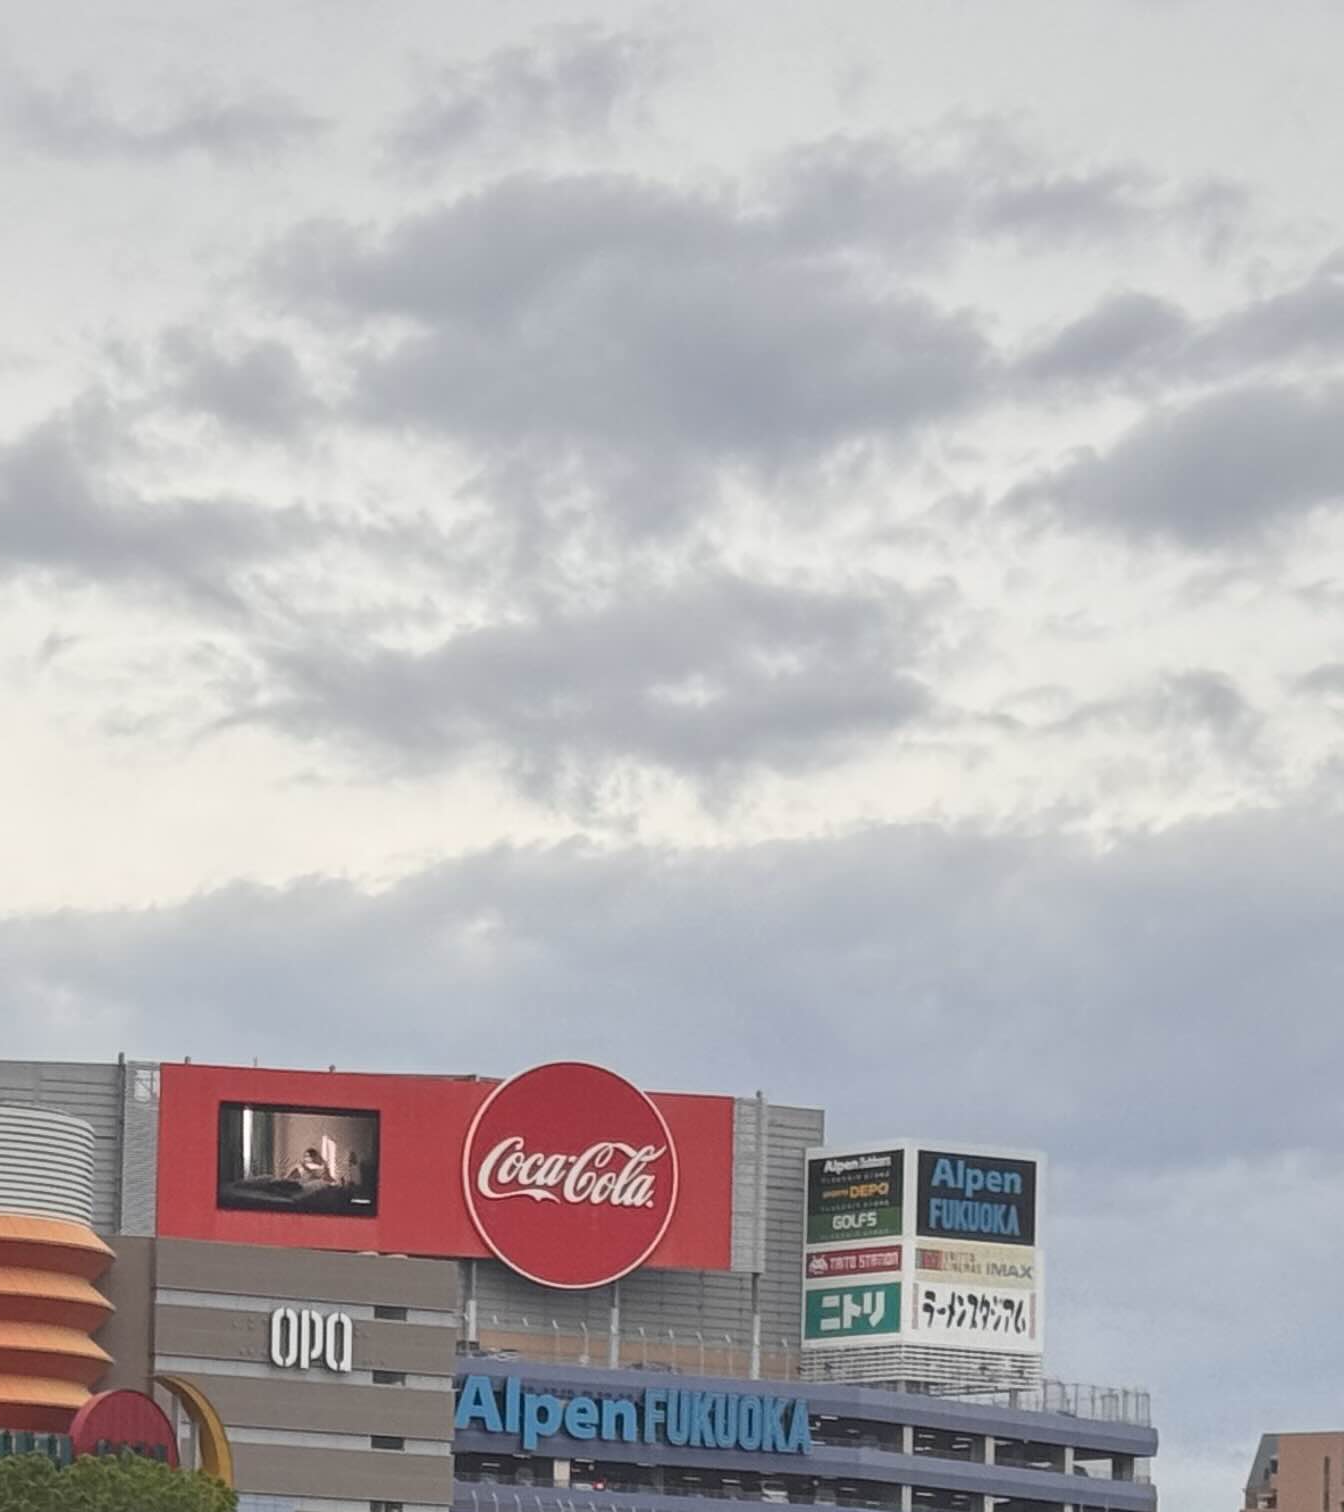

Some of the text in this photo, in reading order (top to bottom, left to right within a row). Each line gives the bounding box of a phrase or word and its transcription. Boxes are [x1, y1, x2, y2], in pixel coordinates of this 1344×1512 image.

[478, 1136, 666, 1209] Coca-Cola
[931, 1157, 1023, 1199] Alpen
[927, 1198, 1022, 1237] FUKUOKA
[985, 1262, 1033, 1280] IMAX
[820, 1290, 886, 1331] ニトリ
[455, 1373, 812, 1455] Alpen FUKUOKA
